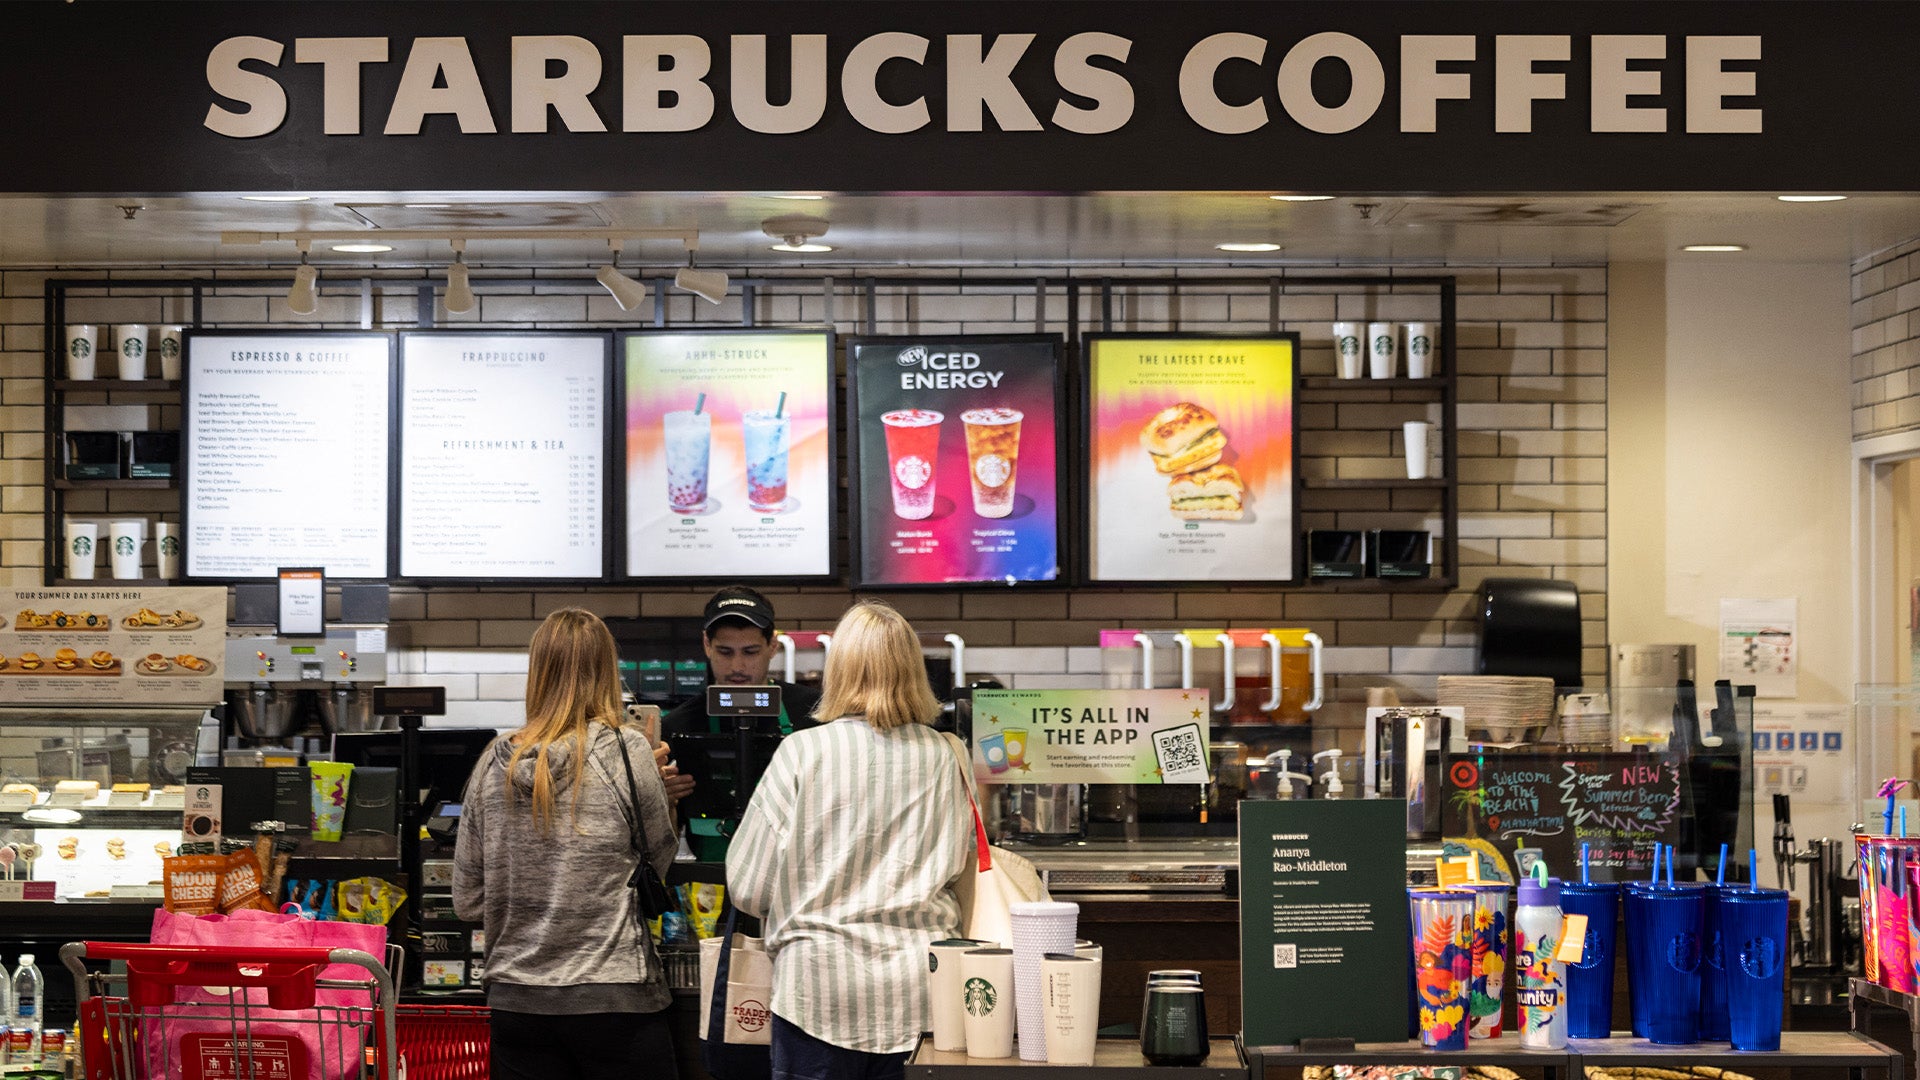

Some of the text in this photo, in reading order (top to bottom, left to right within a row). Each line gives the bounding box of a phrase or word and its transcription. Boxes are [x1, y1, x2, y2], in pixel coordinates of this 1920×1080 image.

[203, 31, 1763, 138] STARBUCKS COFFEE
[231, 351, 350, 362] ESPRESSO & COFFEE
[462, 352, 546, 362] FRAPPUCCINO
[685, 350, 767, 360] AHHH-STRUCK
[900, 347, 926, 365] NEW
[921, 352, 981, 370] ICED
[1139, 355, 1245, 365] THE LATEST CRAVE
[901, 371, 1004, 390] ENERGY
[443, 440, 564, 450] REFRESHMENT & TEA
[15, 592, 142, 600] YOUR SUMMER DAY STARTS HERE
[718, 598, 756, 608] STARBUCKS
[1081, 708, 1118, 724] ALL
[1127, 708, 1149, 724] IN
[1044, 729, 1138, 745] THE APP
[1622, 765, 1660, 786] NEW
[1487, 786, 1504, 797] TO
[1584, 787, 1672, 807] Summer Berry
[1575, 826, 1612, 838] Barista
[1273, 848, 1310, 859] Ananya
[1273, 861, 1347, 872] Rao-Middleton
[171, 871, 216, 887] MOON
[172, 887, 216, 900] CHEESE
[733, 1007, 771, 1019] TRADER
[737, 1016, 764, 1026] JOE'S
